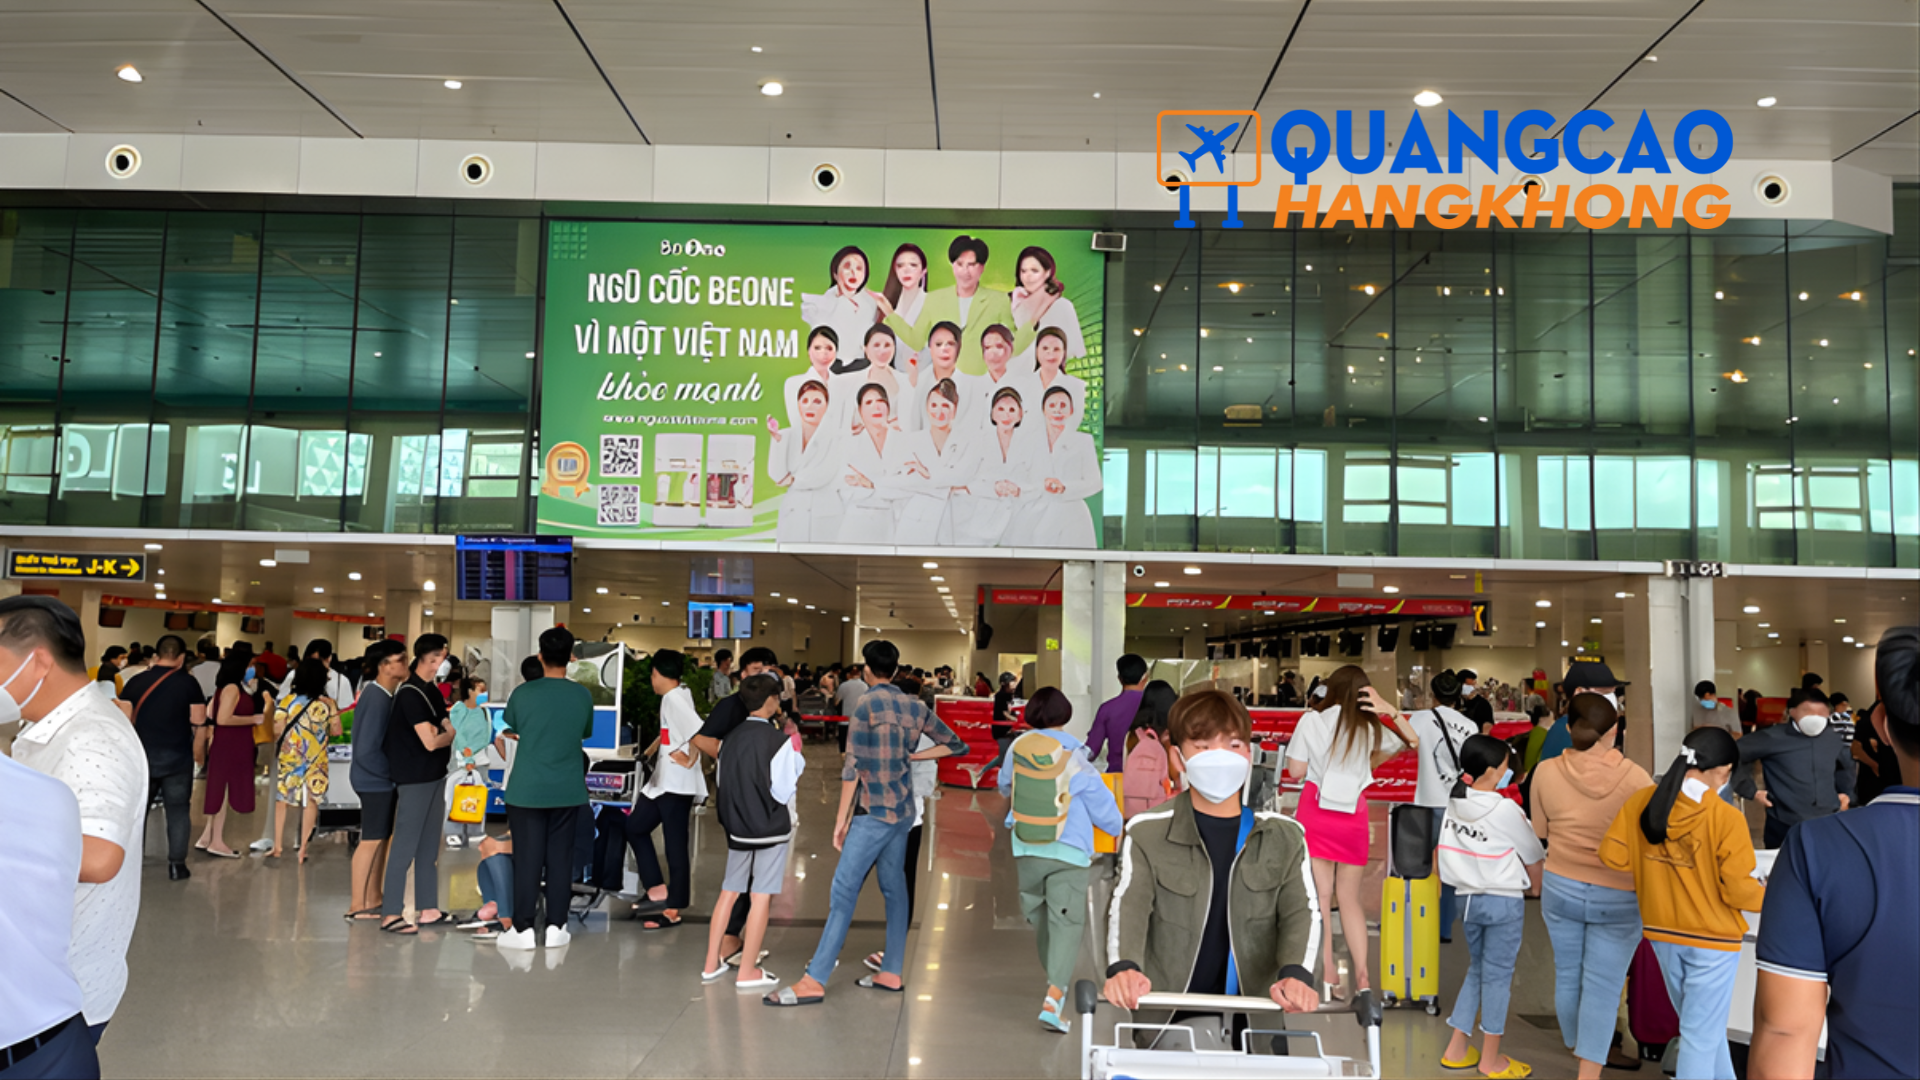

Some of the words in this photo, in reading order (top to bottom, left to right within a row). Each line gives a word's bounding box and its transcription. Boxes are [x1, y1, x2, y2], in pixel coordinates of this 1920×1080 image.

[587, 268, 641, 304] NGŨ
[648, 266, 701, 305] CỐC
[708, 275, 796, 307] BEONE
[574, 318, 600, 355] VÌ
[607, 319, 667, 361] MỘT
[673, 321, 732, 363] VIỆT
[738, 327, 799, 359] NAM
